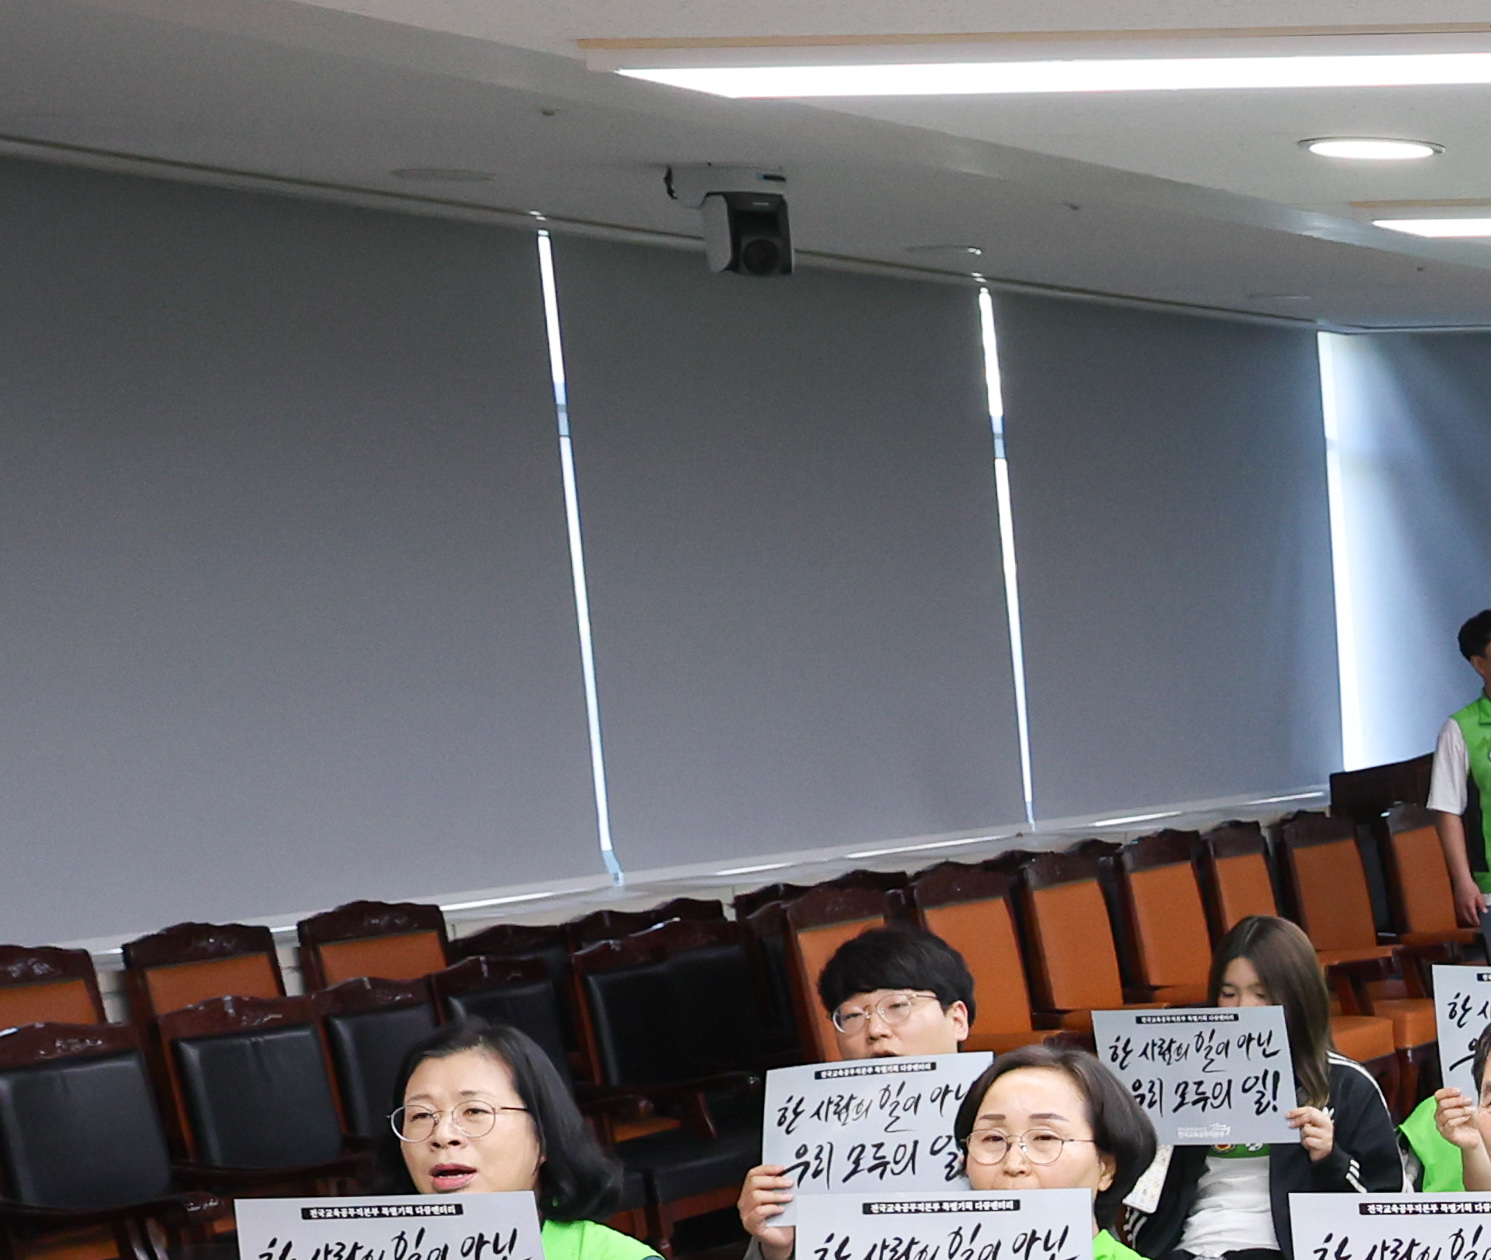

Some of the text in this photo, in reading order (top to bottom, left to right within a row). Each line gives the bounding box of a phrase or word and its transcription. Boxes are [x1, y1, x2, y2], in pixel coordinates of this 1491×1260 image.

[1108, 1028, 1279, 1072] 한 사람의 일이 아닌
